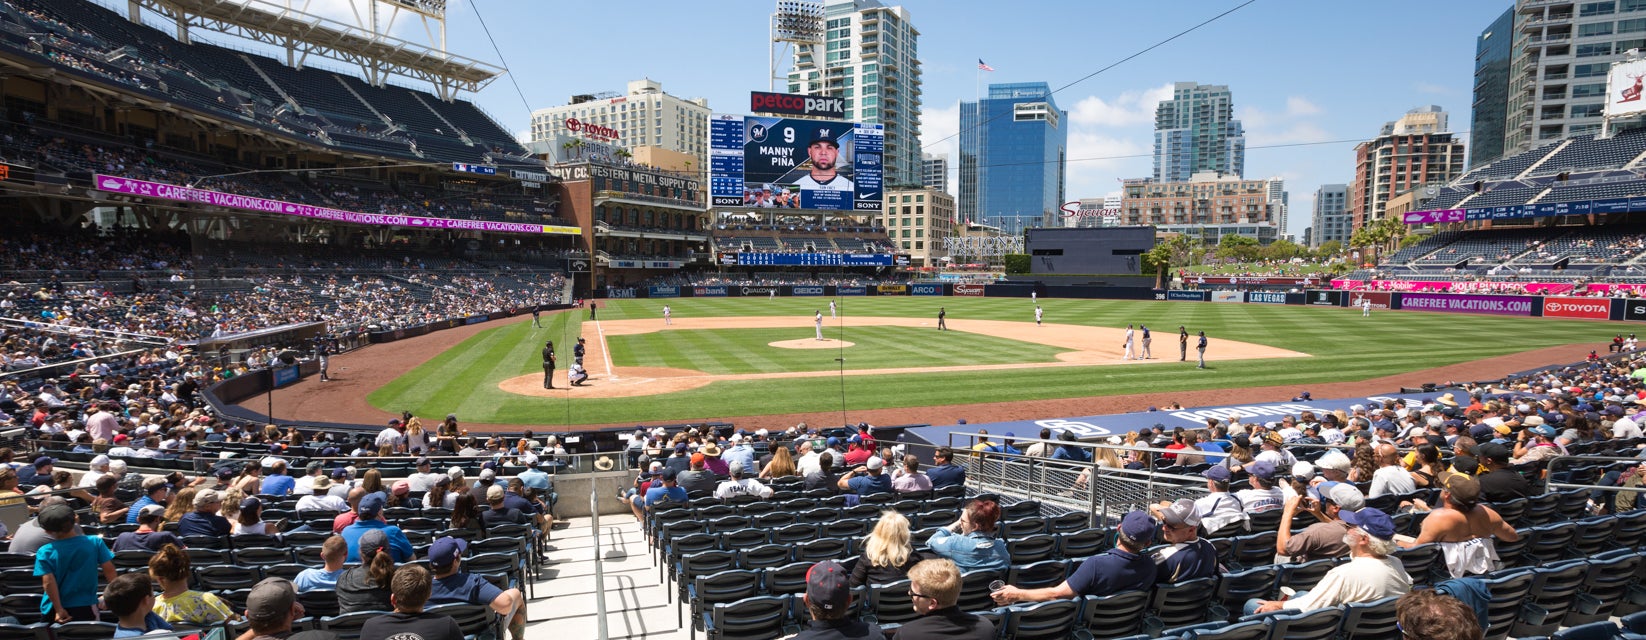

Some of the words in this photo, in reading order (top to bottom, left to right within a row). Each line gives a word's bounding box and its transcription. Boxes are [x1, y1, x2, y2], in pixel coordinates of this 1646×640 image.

[584, 123, 620, 139] TOYOTA
[784, 127, 795, 143] 9
[581, 142, 610, 158] PADRES
[760, 146, 795, 156] MANNY
[772, 156, 795, 166] PIÑA
[574, 167, 589, 178] CO.
[591, 165, 630, 180] WESTERN
[633, 173, 658, 185] METAL
[659, 177, 685, 189] SUPPLY
[688, 182, 699, 192] CO.
[157, 186, 210, 203] CAREFREE
[213, 194, 282, 212] VACATIONS.COM
[314, 208, 344, 220] CAREFREE
[346, 212, 408, 224] VACATIONS.COM
[1060, 201, 1119, 221] Sycuan
[447, 220, 484, 230] CAREFREE
[487, 223, 540, 232] VACATIONS.COM
[609, 290, 636, 298] ASML
[957, 285, 980, 294] Sycuan
[1250, 293, 1262, 302] LAS
[1263, 294, 1285, 303] VEGAS
[1402, 298, 1446, 308] CAREFREE
[1449, 300, 1531, 312] VACATIONS.COM
[1563, 303, 1607, 312] TOYOTA
